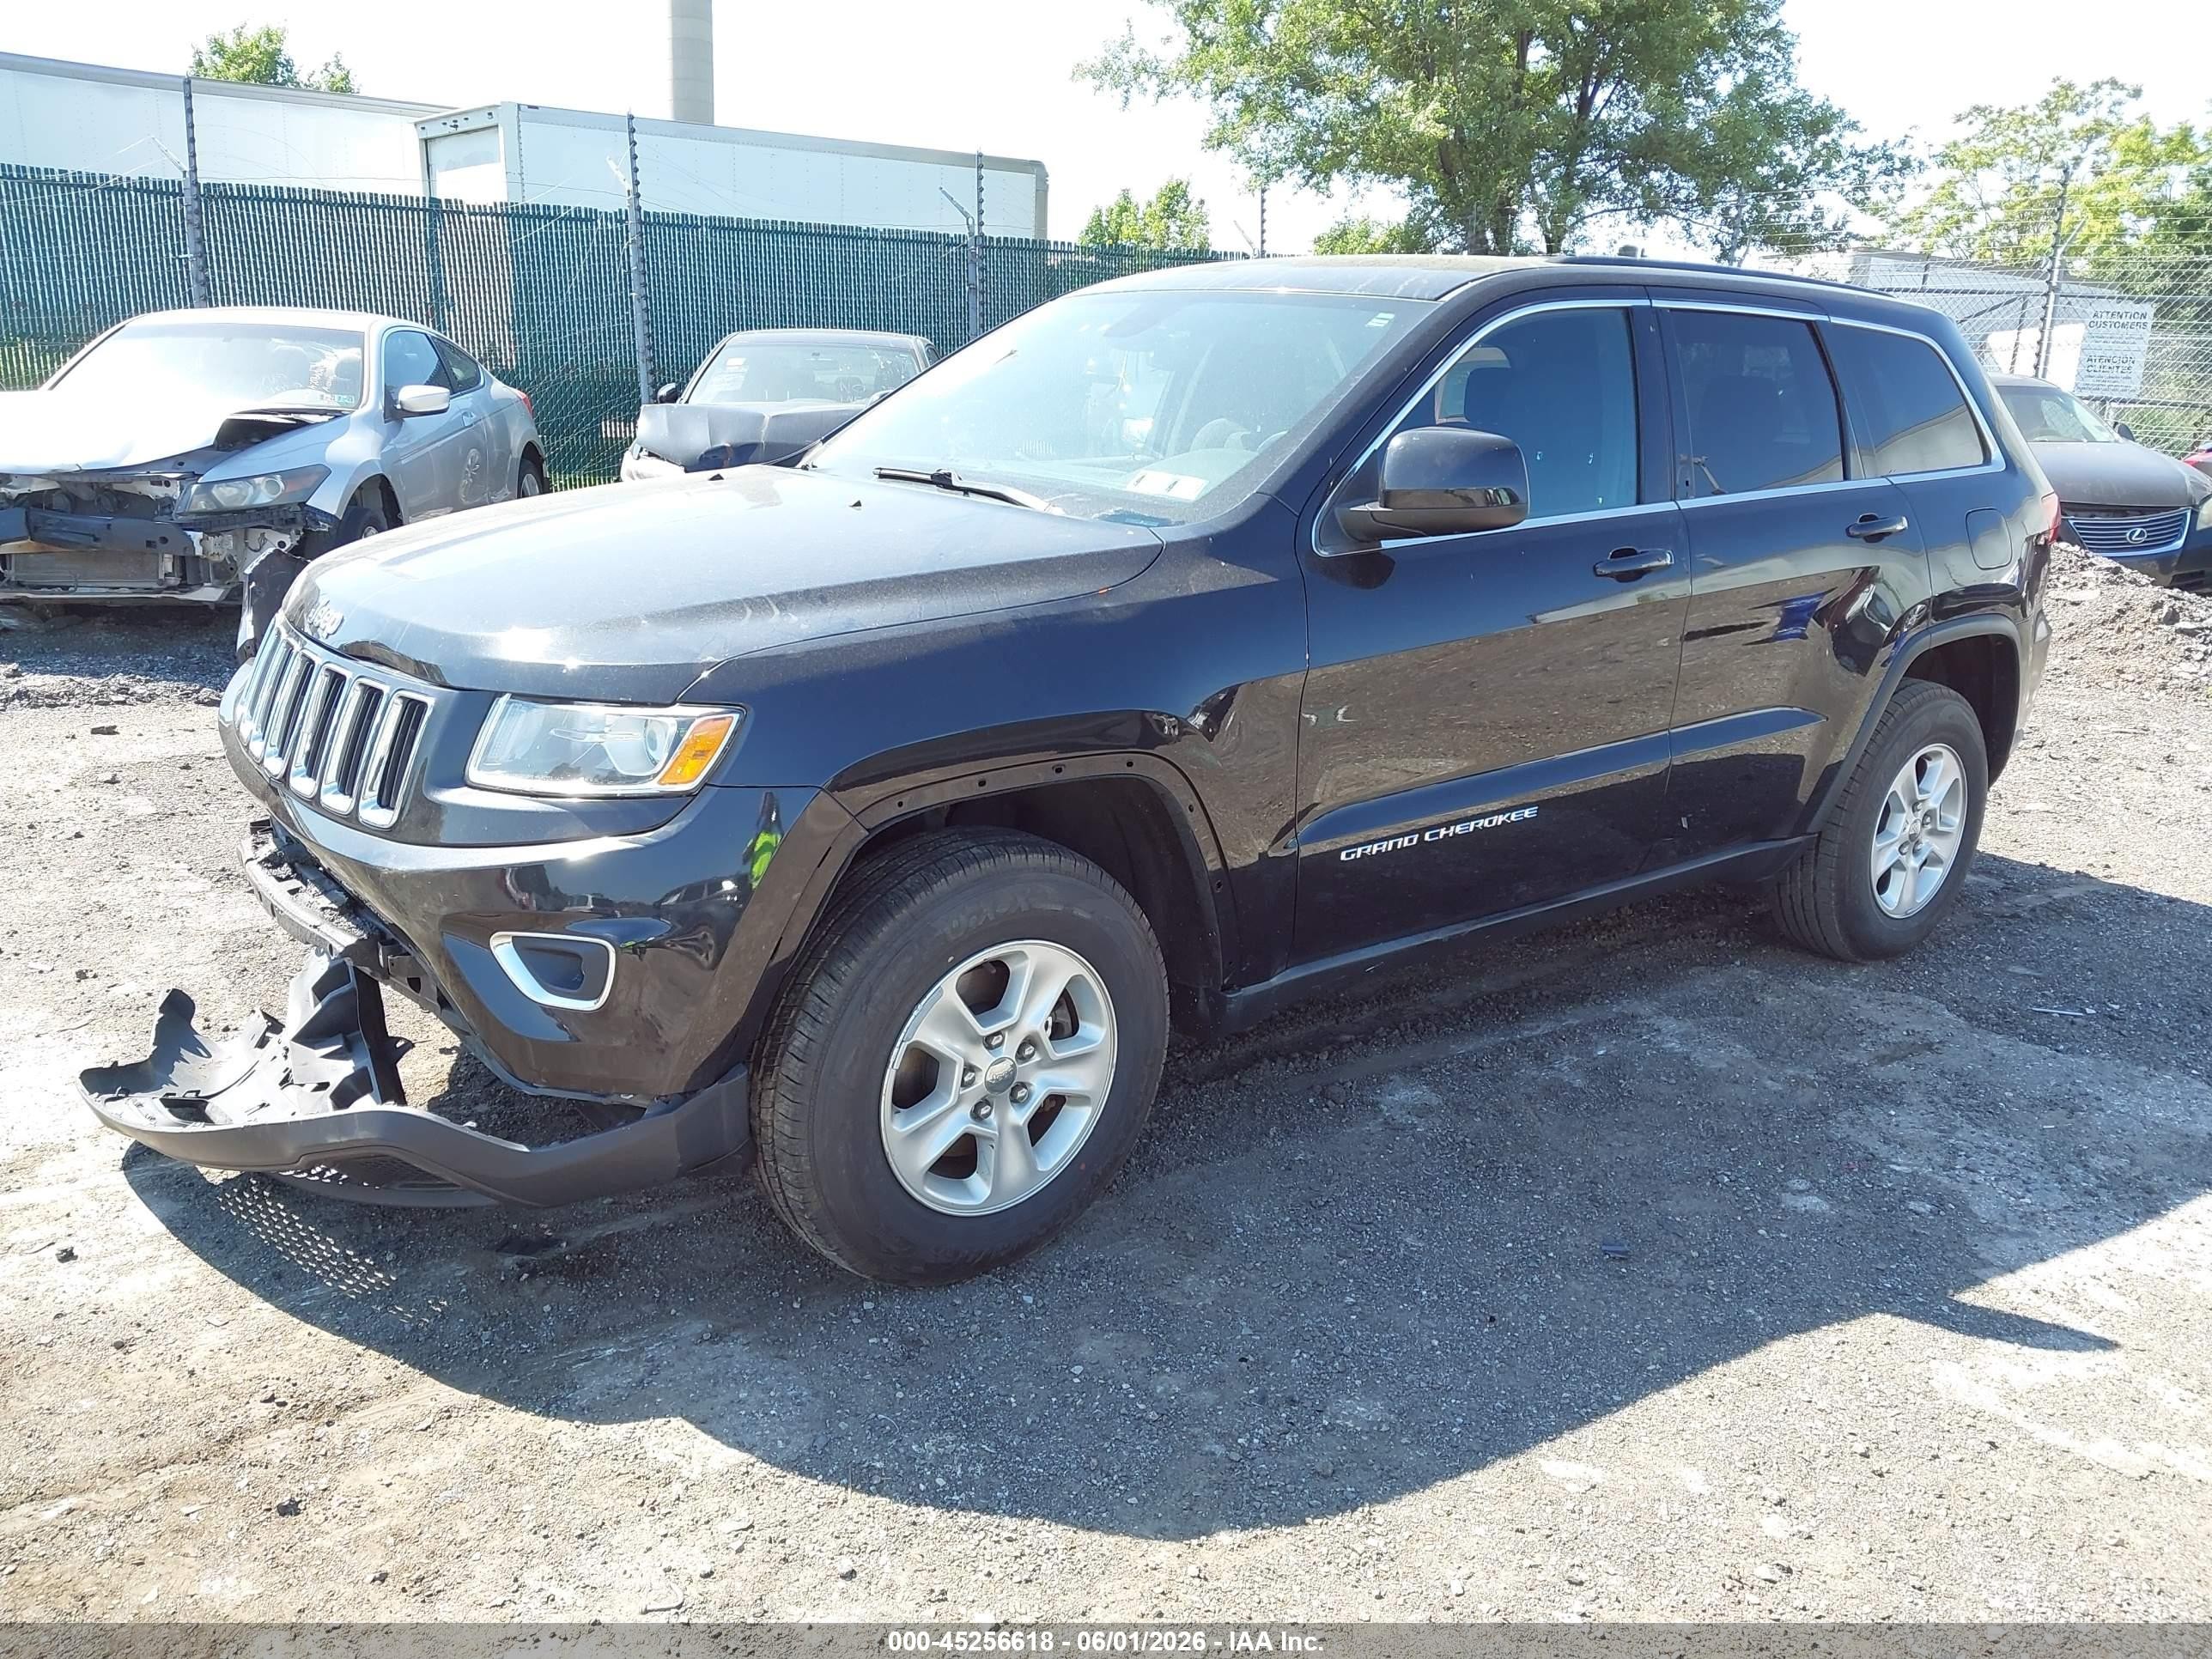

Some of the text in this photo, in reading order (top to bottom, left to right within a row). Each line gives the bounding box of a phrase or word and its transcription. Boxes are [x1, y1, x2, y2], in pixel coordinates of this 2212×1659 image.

[2093, 310, 2148, 320] ATTENTION
[2087, 319, 2149, 330] CUSTOMERS
[2086, 364, 2133, 374] CLIENTES
[1340, 805, 1539, 861] GRAND CHEROKEE
